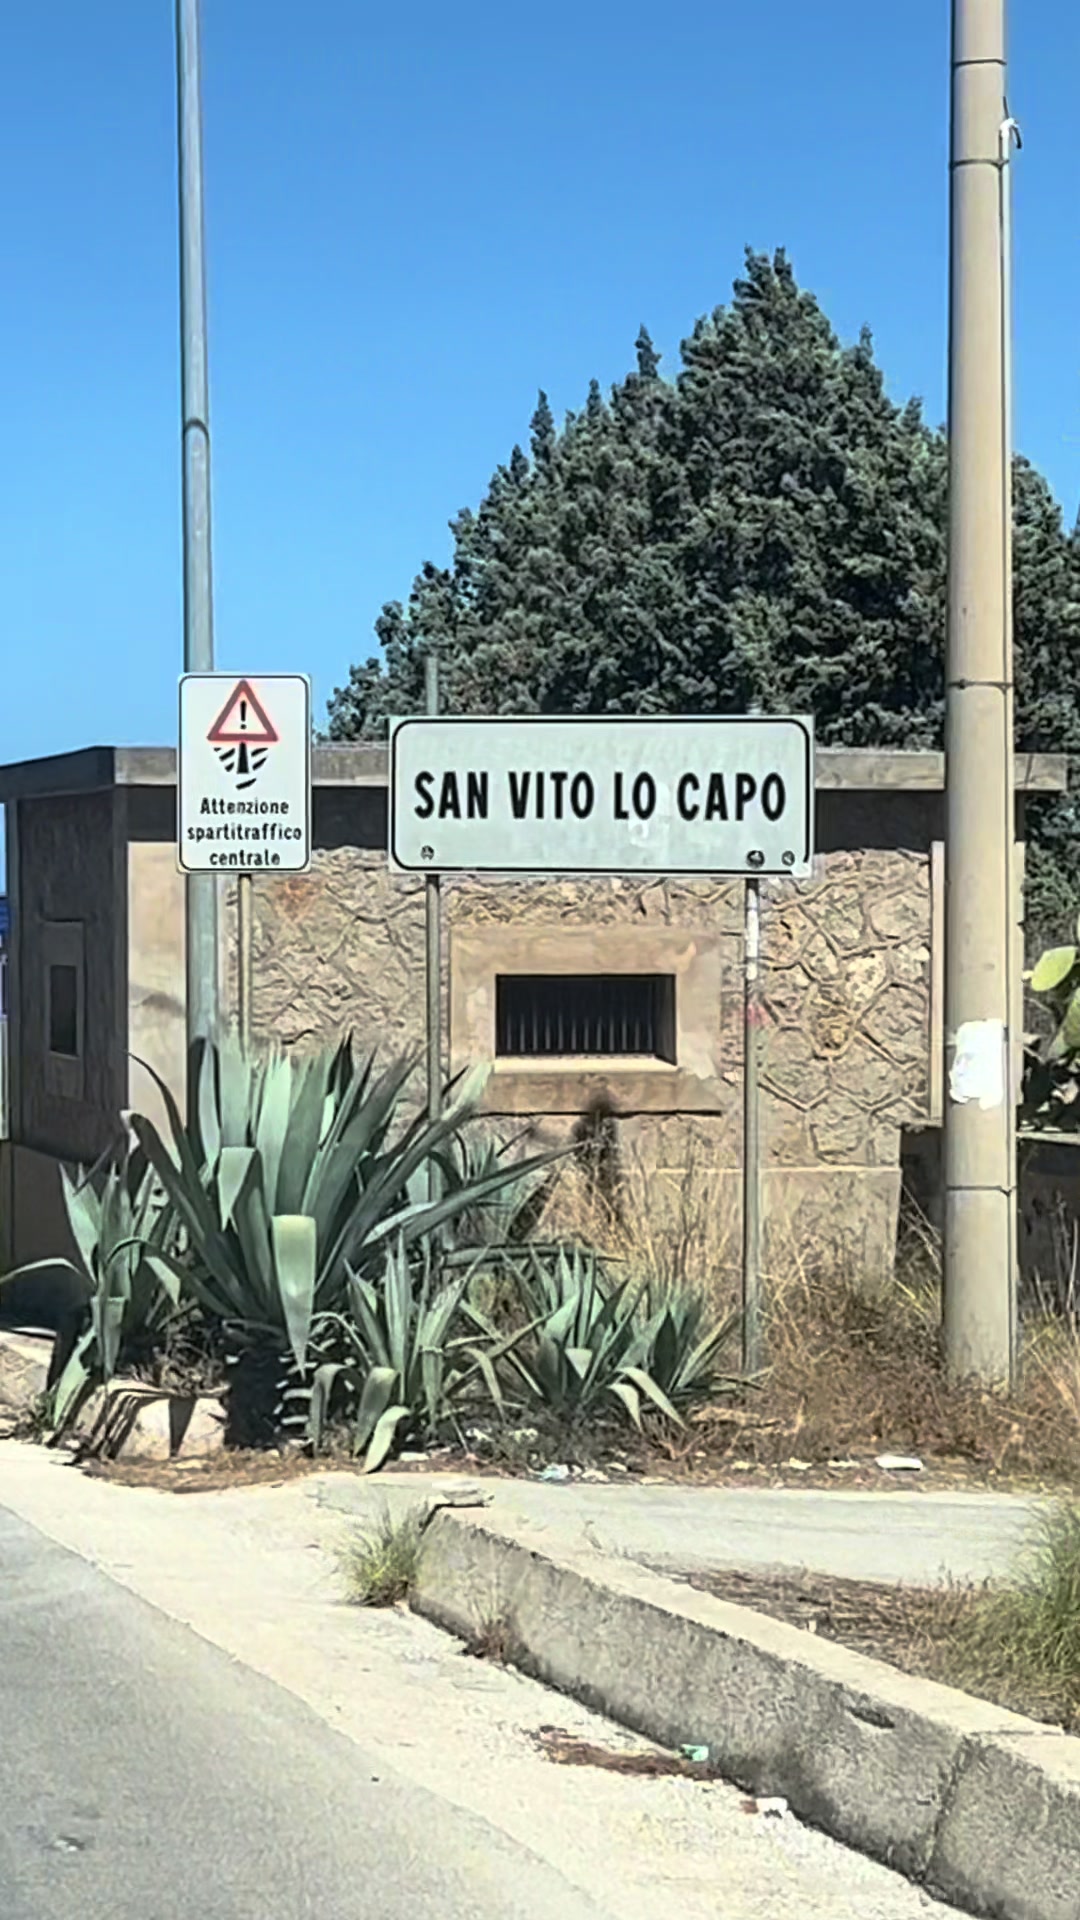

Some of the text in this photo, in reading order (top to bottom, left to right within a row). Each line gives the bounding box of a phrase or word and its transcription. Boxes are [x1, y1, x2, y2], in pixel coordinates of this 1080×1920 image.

[414, 771, 786, 821] SAN VITO LO CAPO
[200, 797, 289, 814] Attenzione
[187, 823, 302, 843] spartitraffico
[209, 849, 280, 866] centrale
